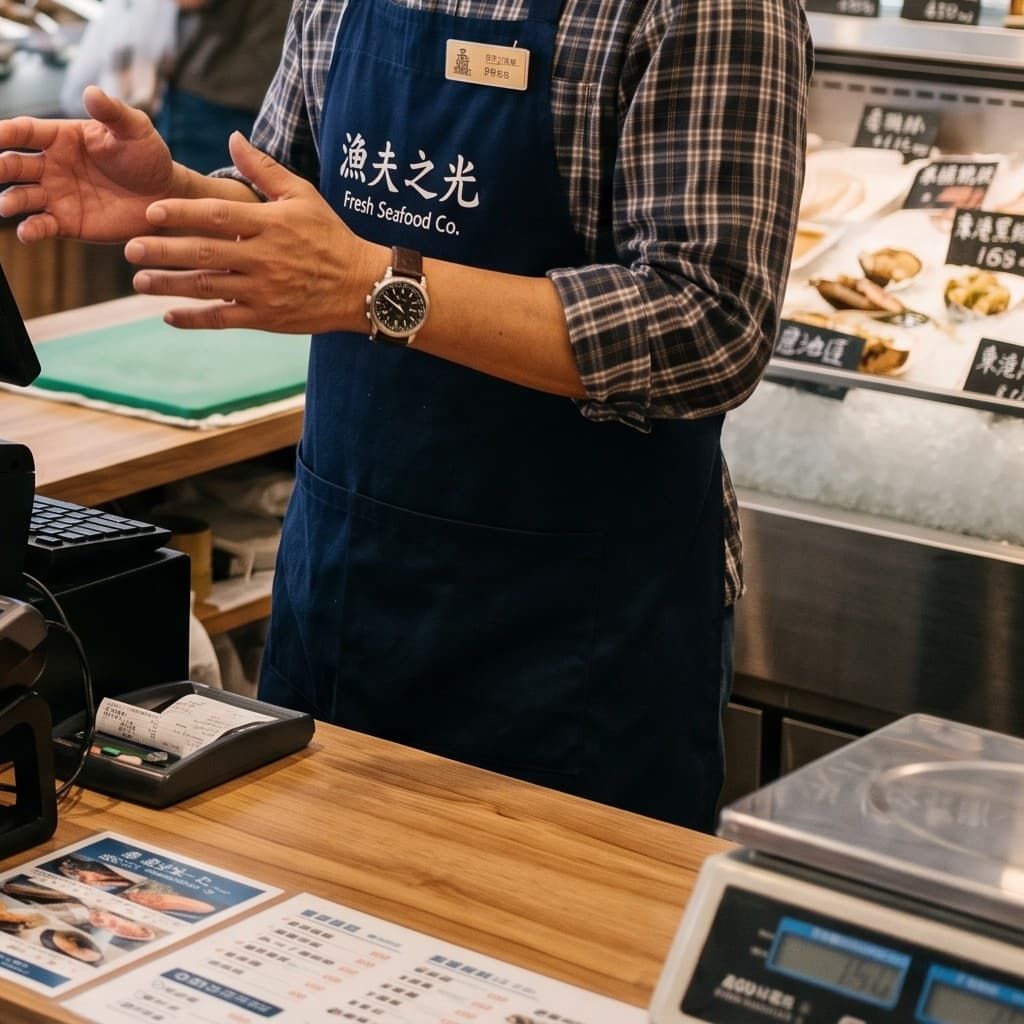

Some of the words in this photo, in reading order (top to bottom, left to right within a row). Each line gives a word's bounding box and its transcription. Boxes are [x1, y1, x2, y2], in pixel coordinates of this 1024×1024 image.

[339, 132, 480, 208] 漁夫之光
[343, 190, 374, 216] Fresh
[377, 200, 432, 230] Seafood
[435, 214, 460, 236] Co.
